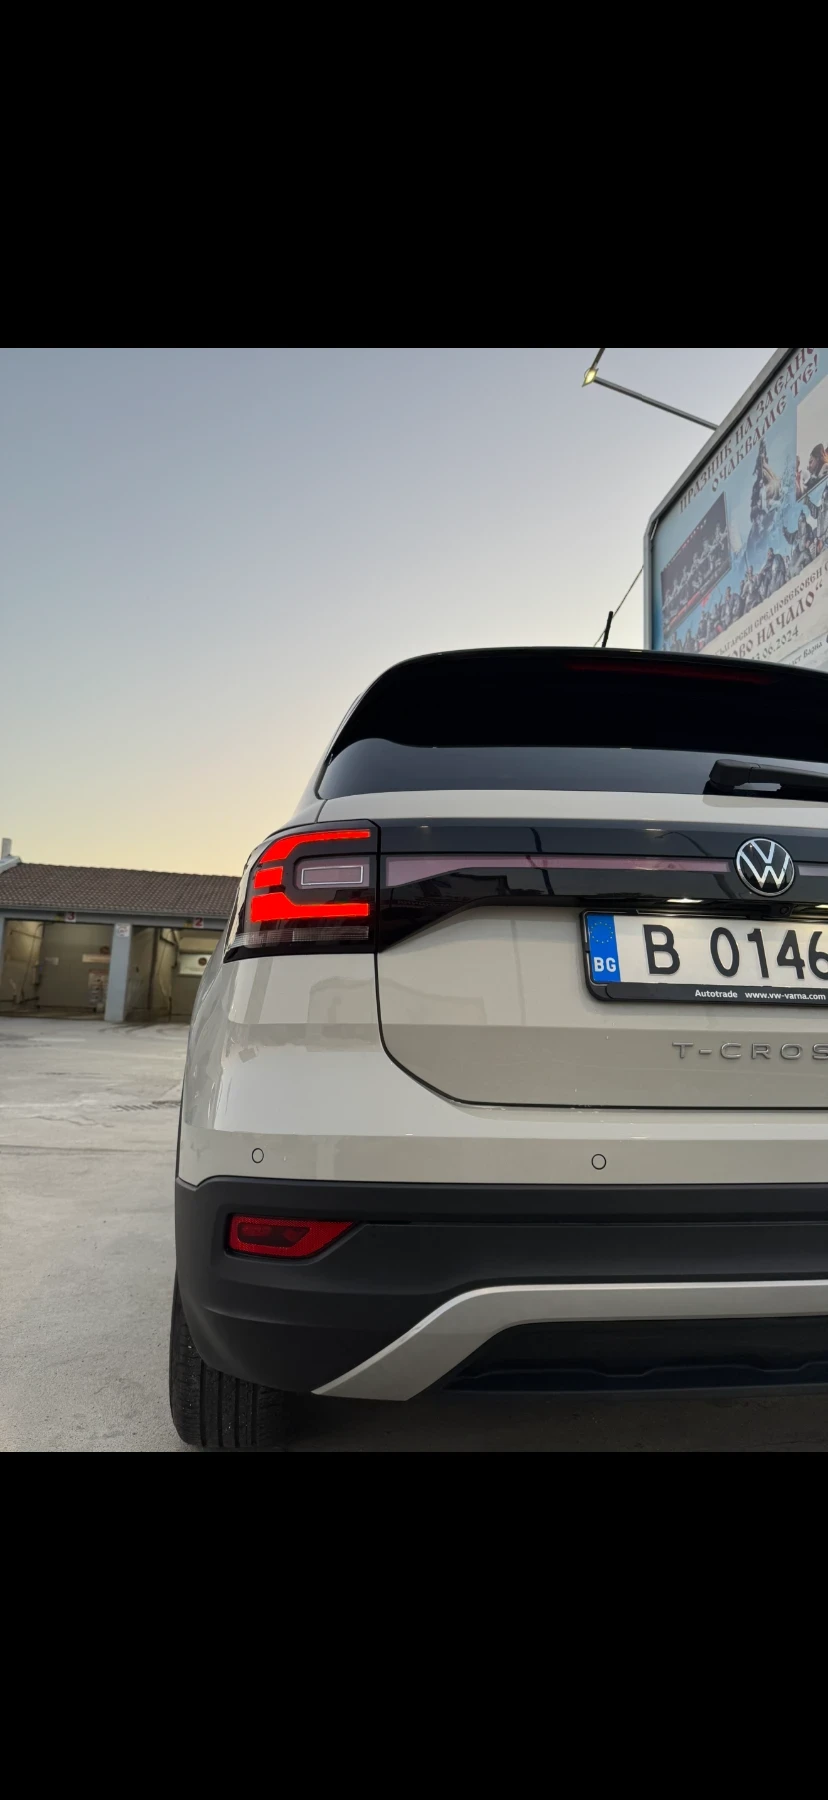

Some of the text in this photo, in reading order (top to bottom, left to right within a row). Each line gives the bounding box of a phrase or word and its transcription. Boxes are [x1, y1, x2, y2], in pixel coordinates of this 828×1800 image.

[712, 353, 818, 492] ОЧАКВАМЕ ТЕ!
[680, 439, 732, 514] ПРАЗНИК
[735, 415, 753, 446] НА
[754, 567, 823, 628] СРЕДНОВЕКОВЕН
[728, 639, 754, 658] ОВО
[751, 624, 799, 660] 306.2024
[593, 956, 617, 973] BG
[643, 924, 828, 981] B 0146
[694, 988, 827, 1001] Autotrade www.vw-varna.com
[672, 1042, 828, 1060] T-CROS
